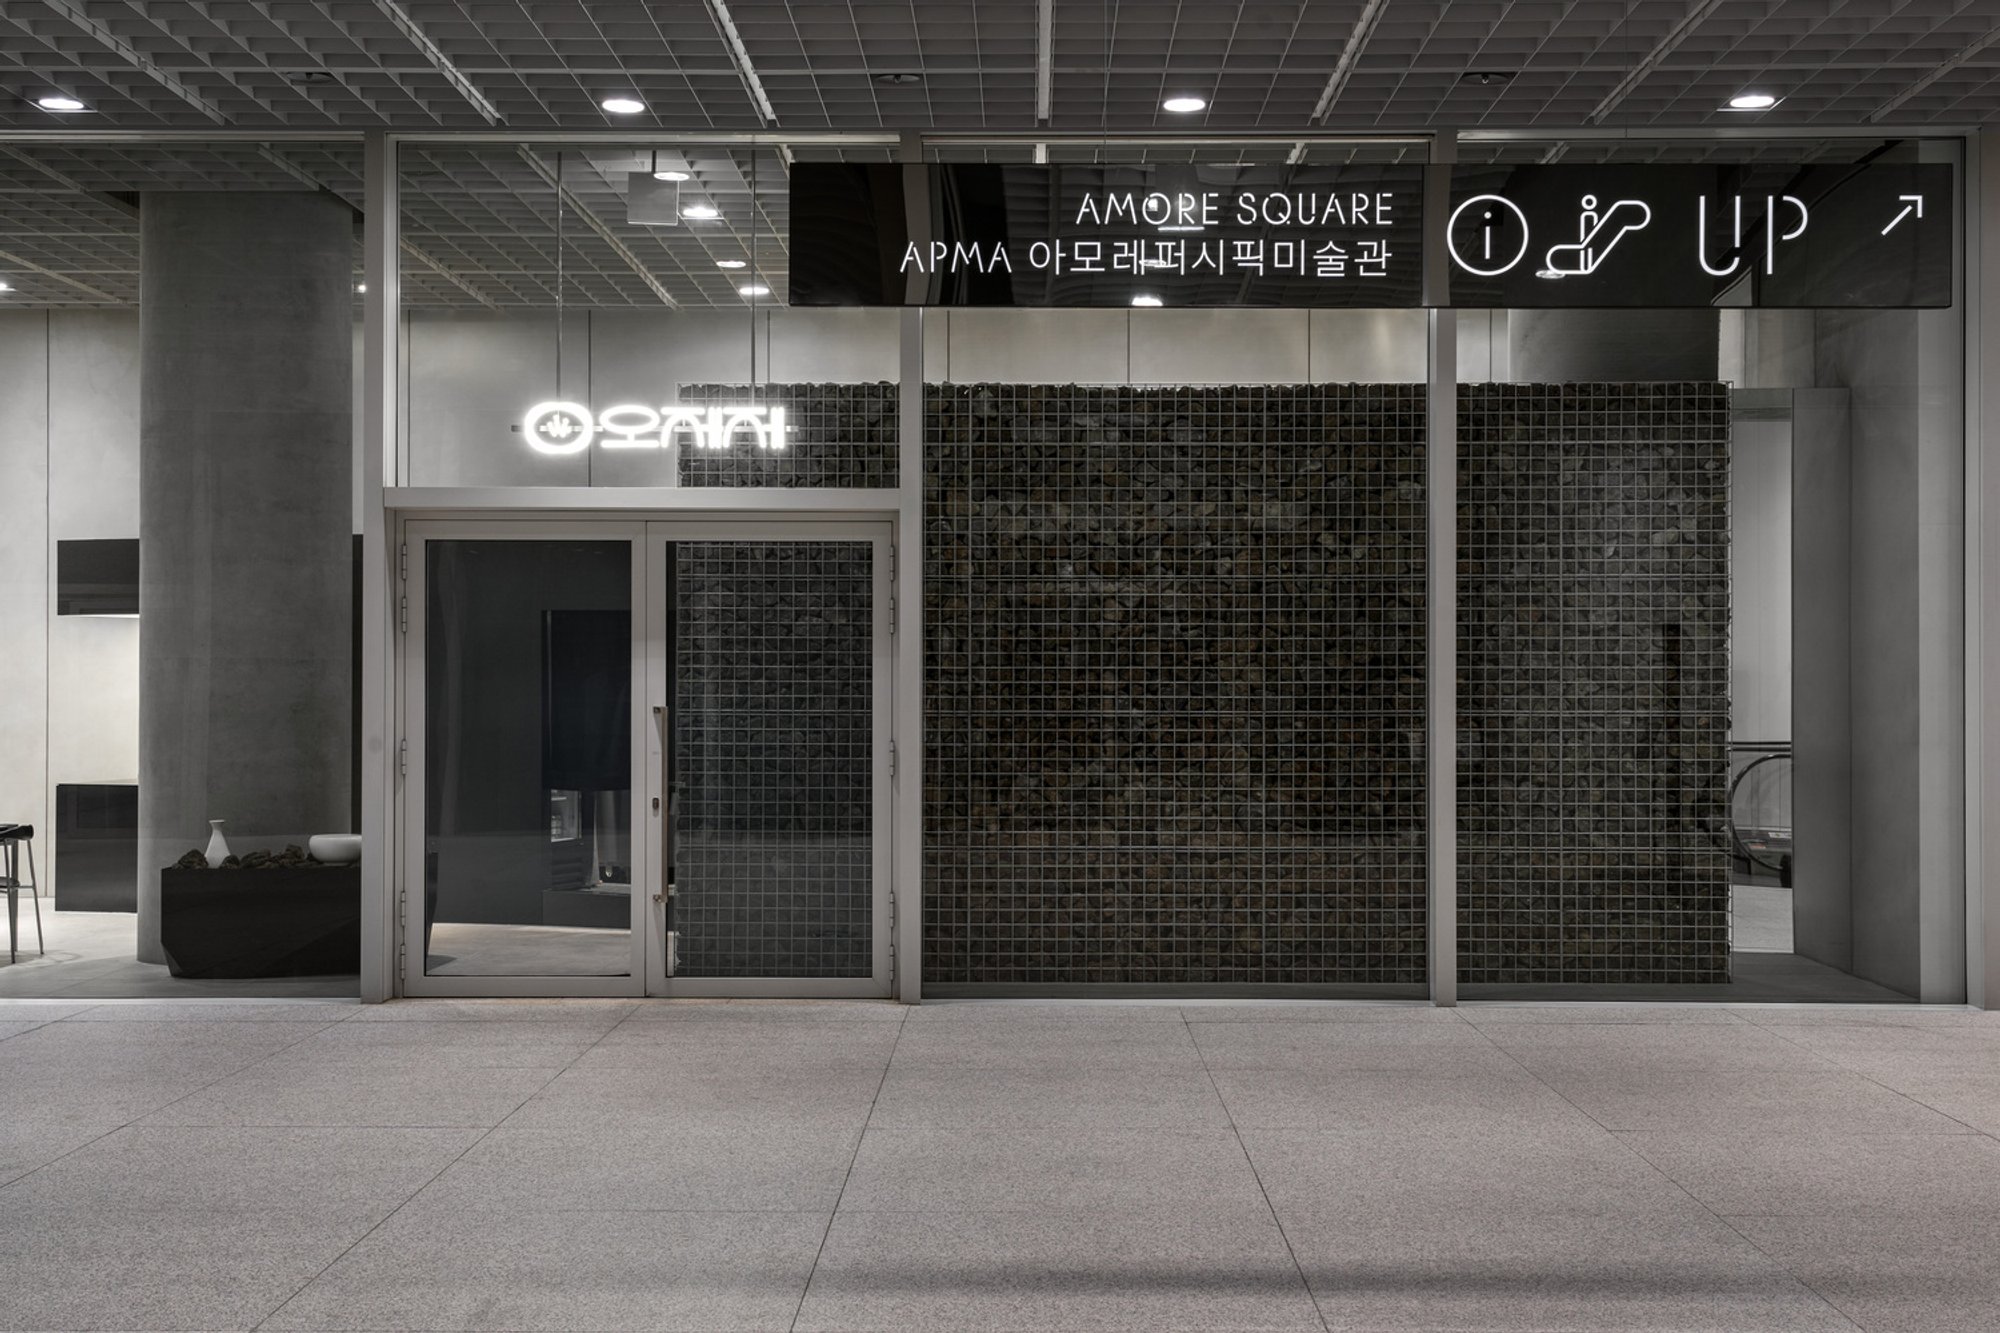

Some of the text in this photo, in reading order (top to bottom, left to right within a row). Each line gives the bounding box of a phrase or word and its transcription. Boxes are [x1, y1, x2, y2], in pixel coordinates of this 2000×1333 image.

[1075, 192, 1394, 225] AMORE SQUARE
[1698, 195, 1808, 276] UP
[899, 239, 1393, 277] APMA 아모레퍼시픽미술관
[599, 404, 786, 450] 오제제
